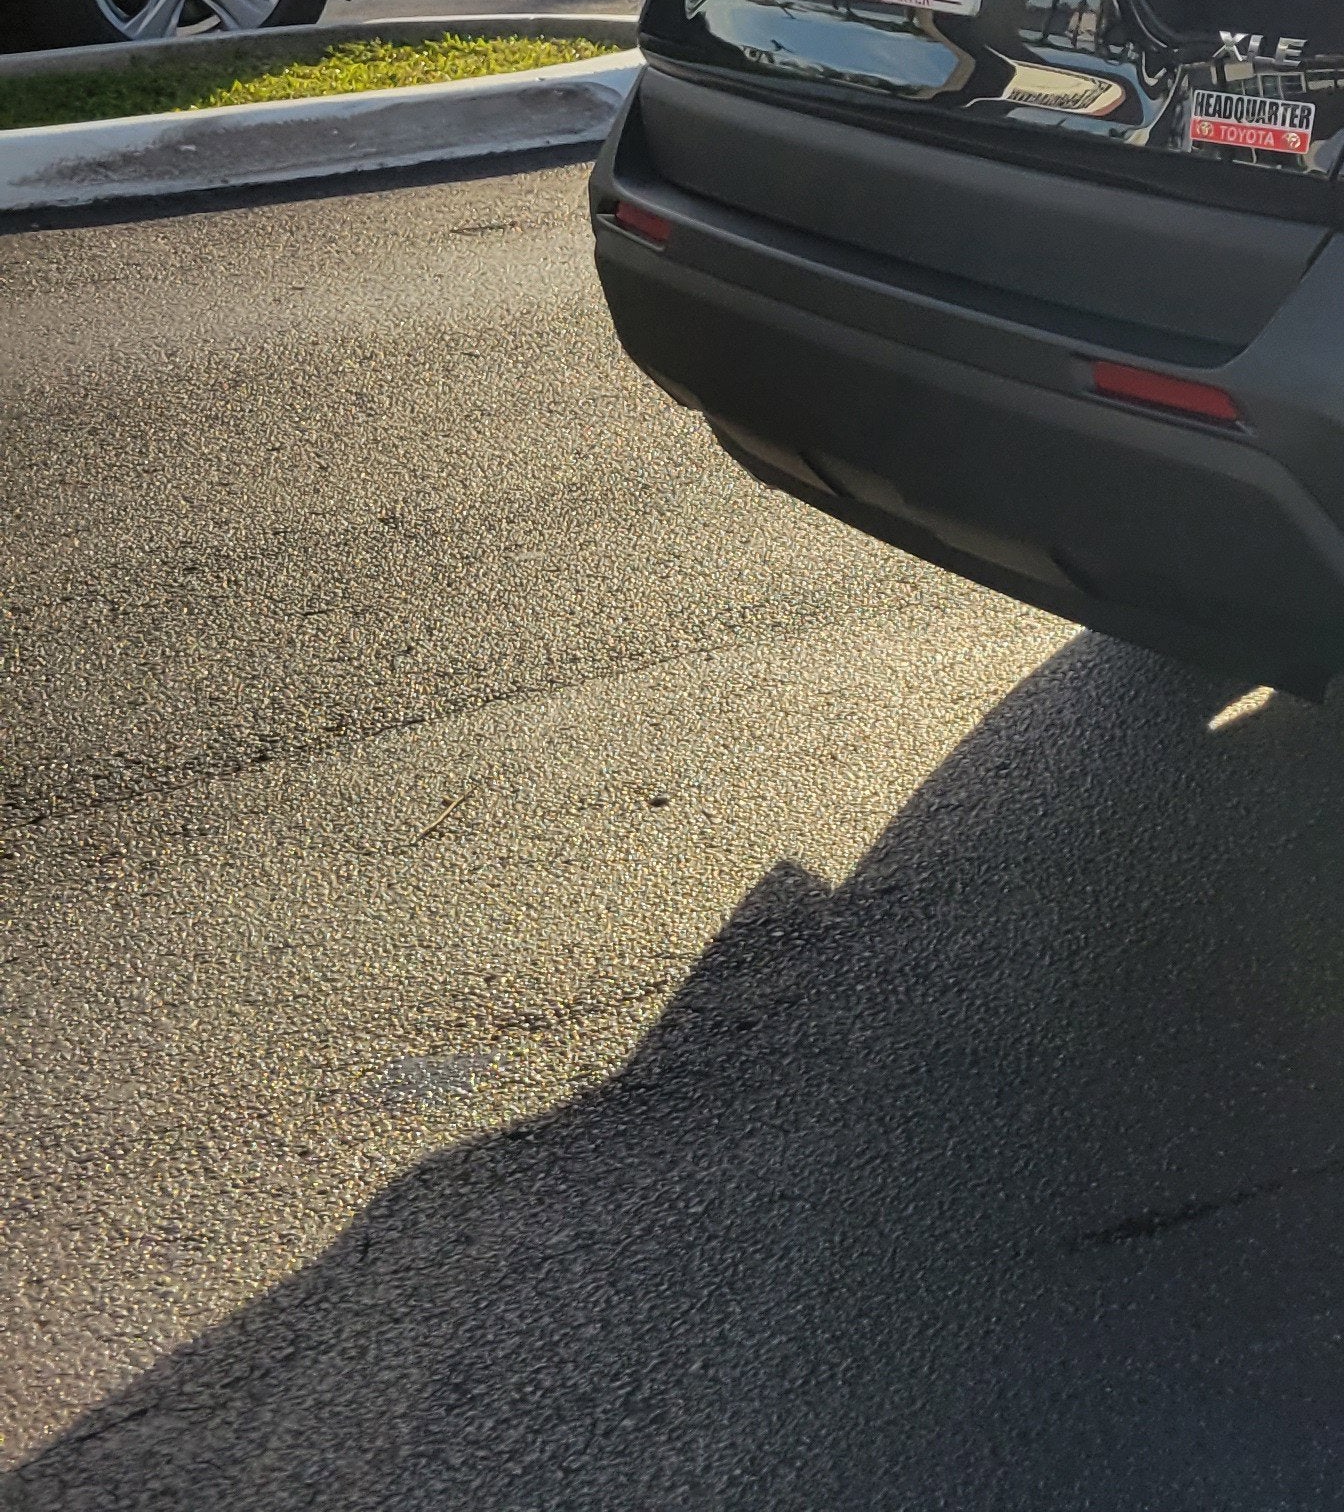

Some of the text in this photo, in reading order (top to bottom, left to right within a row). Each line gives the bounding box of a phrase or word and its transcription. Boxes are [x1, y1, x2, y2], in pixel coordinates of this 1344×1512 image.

[1212, 30, 1308, 67] XLE
[1194, 91, 1312, 130] HEADQUARTER
[1219, 125, 1275, 147] TOYOTA
